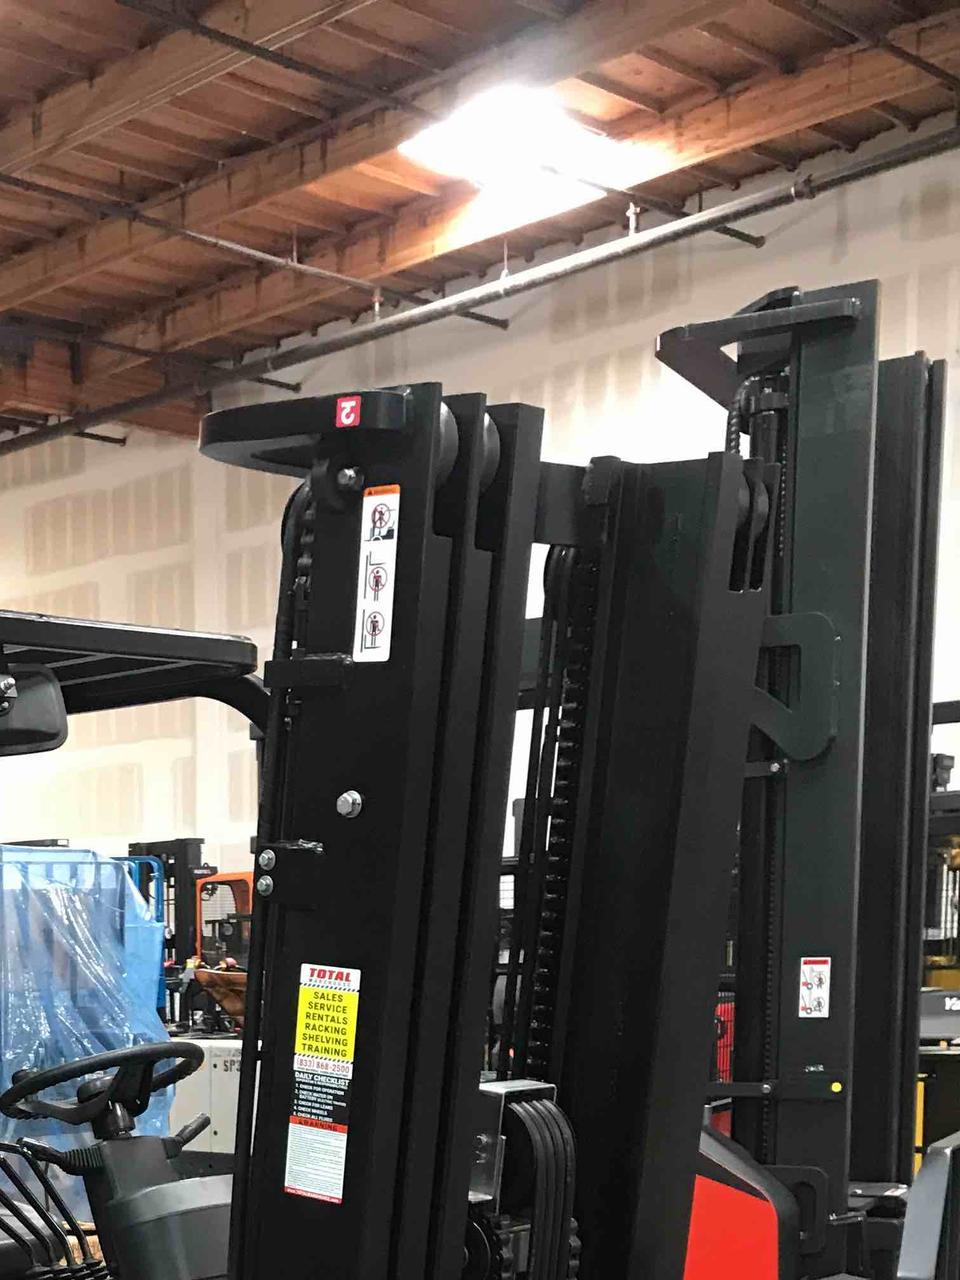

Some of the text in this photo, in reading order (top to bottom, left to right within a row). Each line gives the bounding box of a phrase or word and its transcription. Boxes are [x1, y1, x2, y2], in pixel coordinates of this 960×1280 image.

[309, 968, 352, 982] TOTAL
[313, 991, 344, 1002] SALES
[308, 1001, 348, 1014] SERVICE
[305, 1012, 348, 1025] RENTALS
[305, 1022, 347, 1036] RACKING
[302, 1033, 348, 1047] SHELVING
[301, 1043, 347, 1058] TRAINING
[295, 1071, 313, 1080] DAILY
[313, 1073, 350, 1086] CHECKLIST
